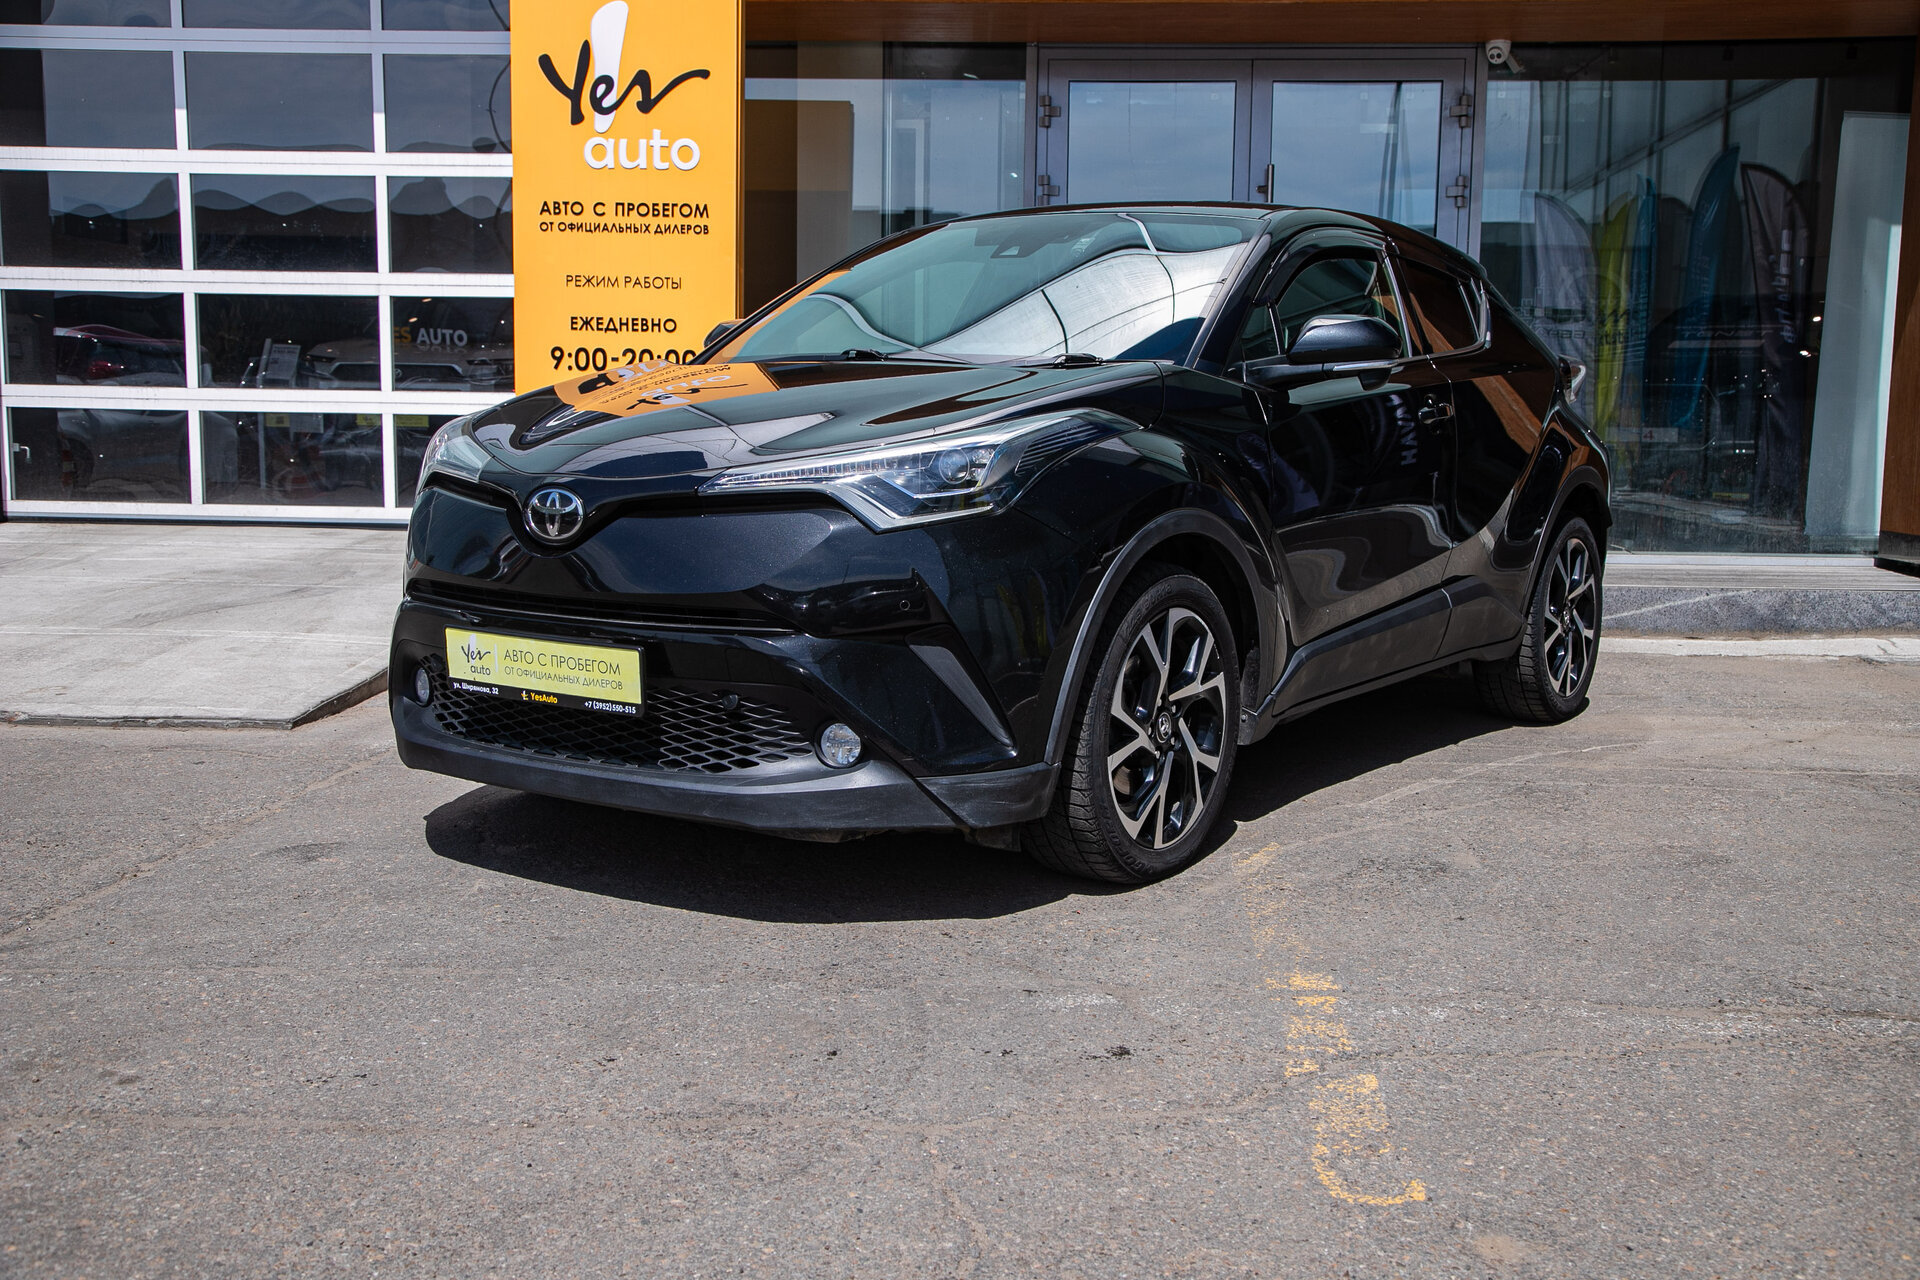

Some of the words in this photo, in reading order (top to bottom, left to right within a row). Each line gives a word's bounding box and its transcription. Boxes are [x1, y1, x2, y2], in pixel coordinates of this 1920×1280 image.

[538, 39, 710, 125] Yes
[584, 129, 700, 170] auto
[539, 201, 584, 215] АВТО
[593, 202, 606, 216] С
[615, 202, 709, 218] ПРОБЕГОМ
[539, 222, 554, 232] ОТ
[558, 222, 650, 234] ОФИЦИАЛЬНЫХ
[654, 224, 709, 235] ДИЛЕРОВ
[566, 275, 619, 288] РЕЖИМ
[624, 276, 681, 290] РАБОТЫ
[570, 316, 677, 333] ЕЖЕДНЕВНО
[416, 328, 468, 347] AUTO
[461, 643, 491, 663] Yes
[504, 649, 534, 665] АВТО
[537, 653, 547, 666] С
[551, 655, 621, 675] ПРОБЕГОМ
[470, 665, 491, 676] auto
[504, 666, 514, 675] ОТ
[516, 667, 580, 685] ОФИЦИАЛЬНЫХ
[582, 678, 623, 690] ДИЛЕРОВ
[530, 692, 558, 704] YesAuto
